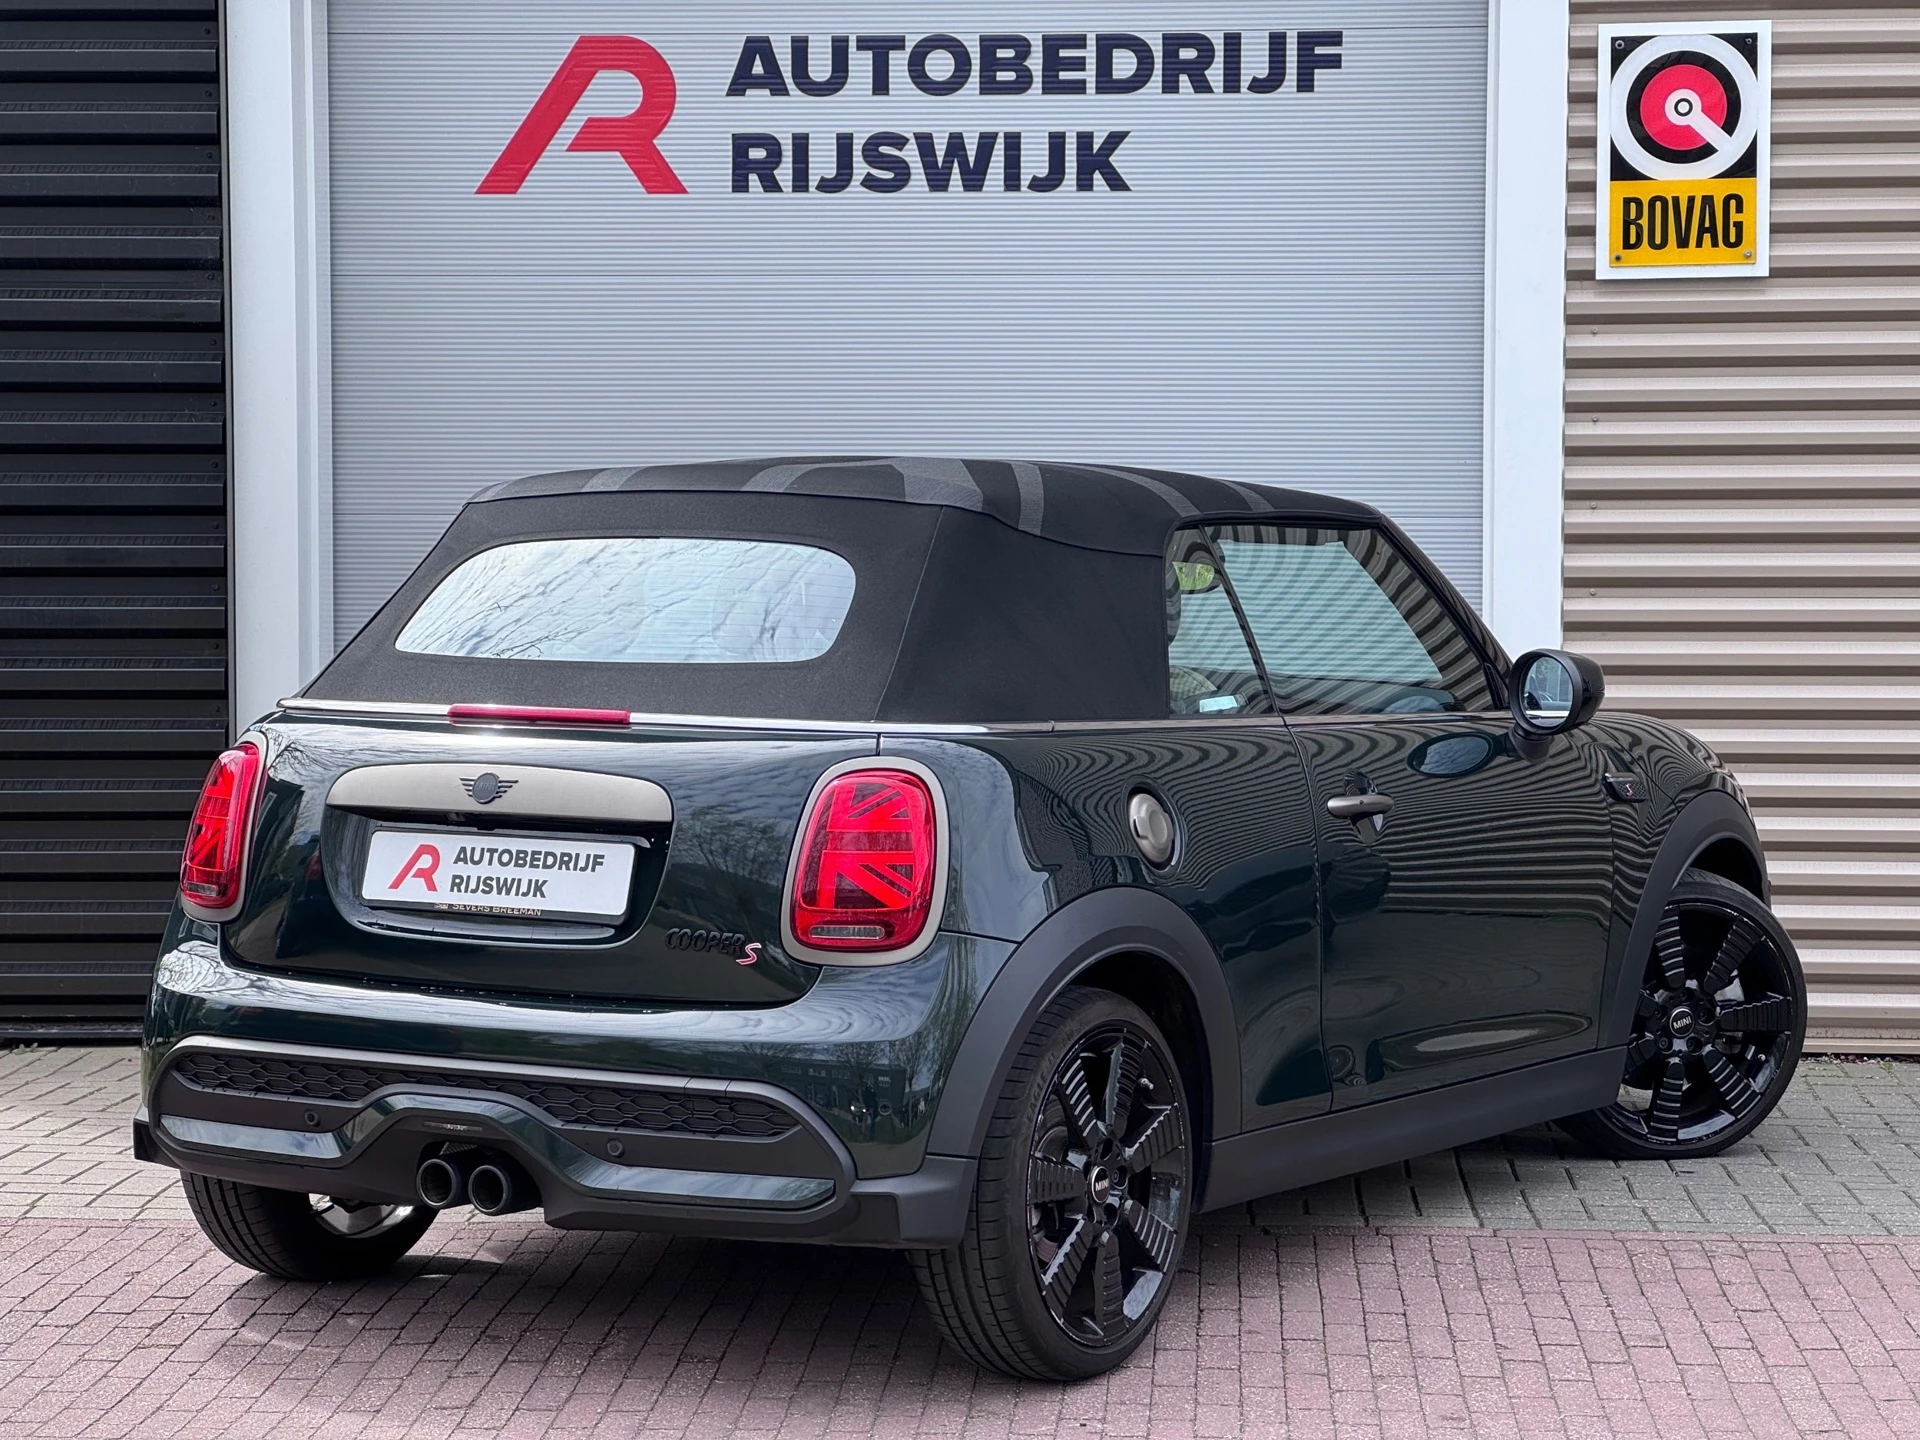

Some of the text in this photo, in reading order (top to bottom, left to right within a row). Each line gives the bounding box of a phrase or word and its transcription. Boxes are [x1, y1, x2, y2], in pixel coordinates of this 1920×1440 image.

[726, 31, 1344, 97] AUTOBEDRIJF
[731, 131, 1132, 194] RIJSWIJK
[1622, 193, 1744, 250] BOVAG
[453, 846, 605, 873] AUTOBEDRIJF
[449, 875, 549, 898] RIJSWIJK
[665, 927, 762, 965] COOPER S
[1673, 1016, 1692, 1030] MINI
